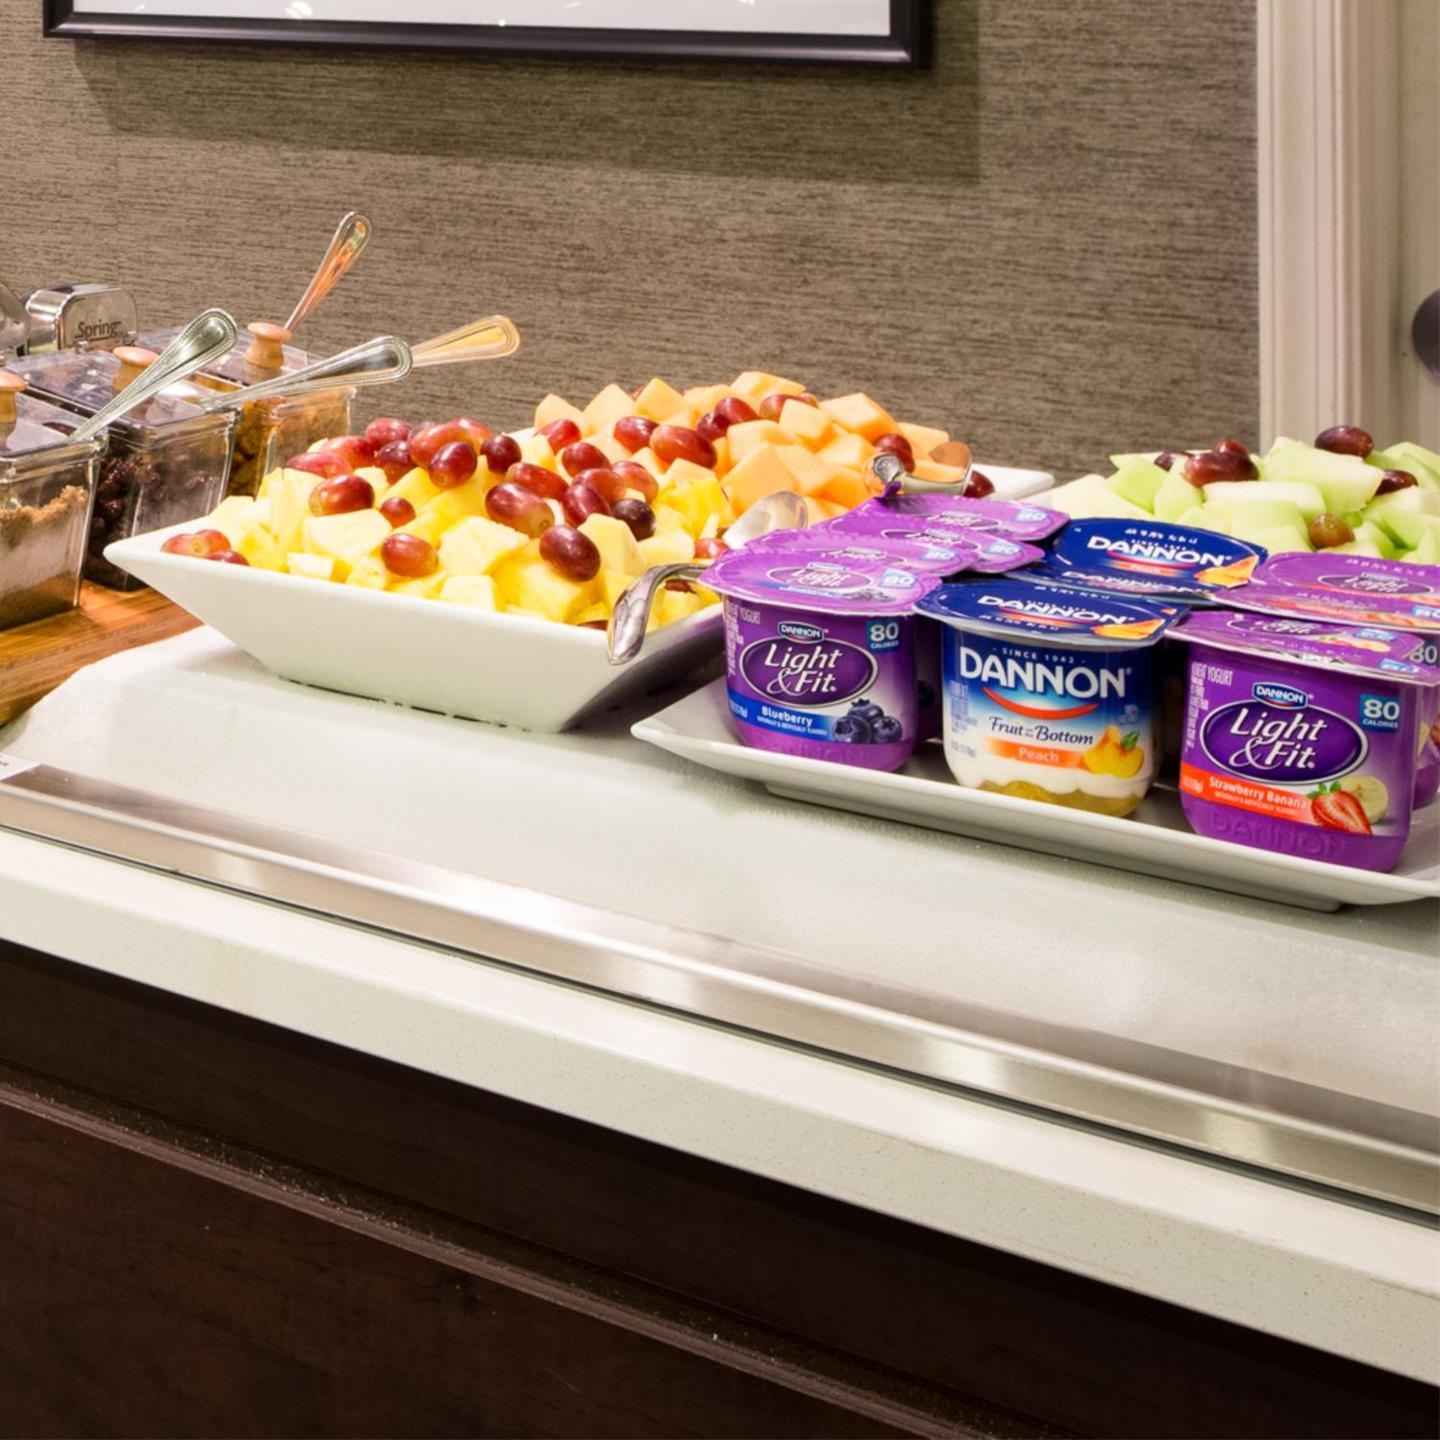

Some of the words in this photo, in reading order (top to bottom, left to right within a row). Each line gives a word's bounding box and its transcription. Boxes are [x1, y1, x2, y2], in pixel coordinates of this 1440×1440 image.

[74, 318, 123, 341] Spring
[1087, 535, 1225, 566] DANNON
[977, 595, 1128, 624] DANNON
[780, 623, 821, 638] DANNON
[869, 621, 900, 643] 80
[763, 643, 843, 675] Light
[1001, 646, 1038, 660] SINCE
[1044, 653, 1075, 664] 1942
[959, 646, 1126, 699] DANNON
[1255, 685, 1306, 705] DANNON
[761, 705, 813, 728] Blueberry
[1362, 699, 1400, 721] 80
[988, 715, 1024, 737] Fruit
[1034, 724, 1095, 746] Bottom
[1230, 707, 1328, 745] Light
[1362, 718, 1399, 729] CALORIES
[1018, 746, 1060, 764] Peach
[1208, 776, 1265, 802] Strawberry
[1267, 790, 1307, 809] Banana
